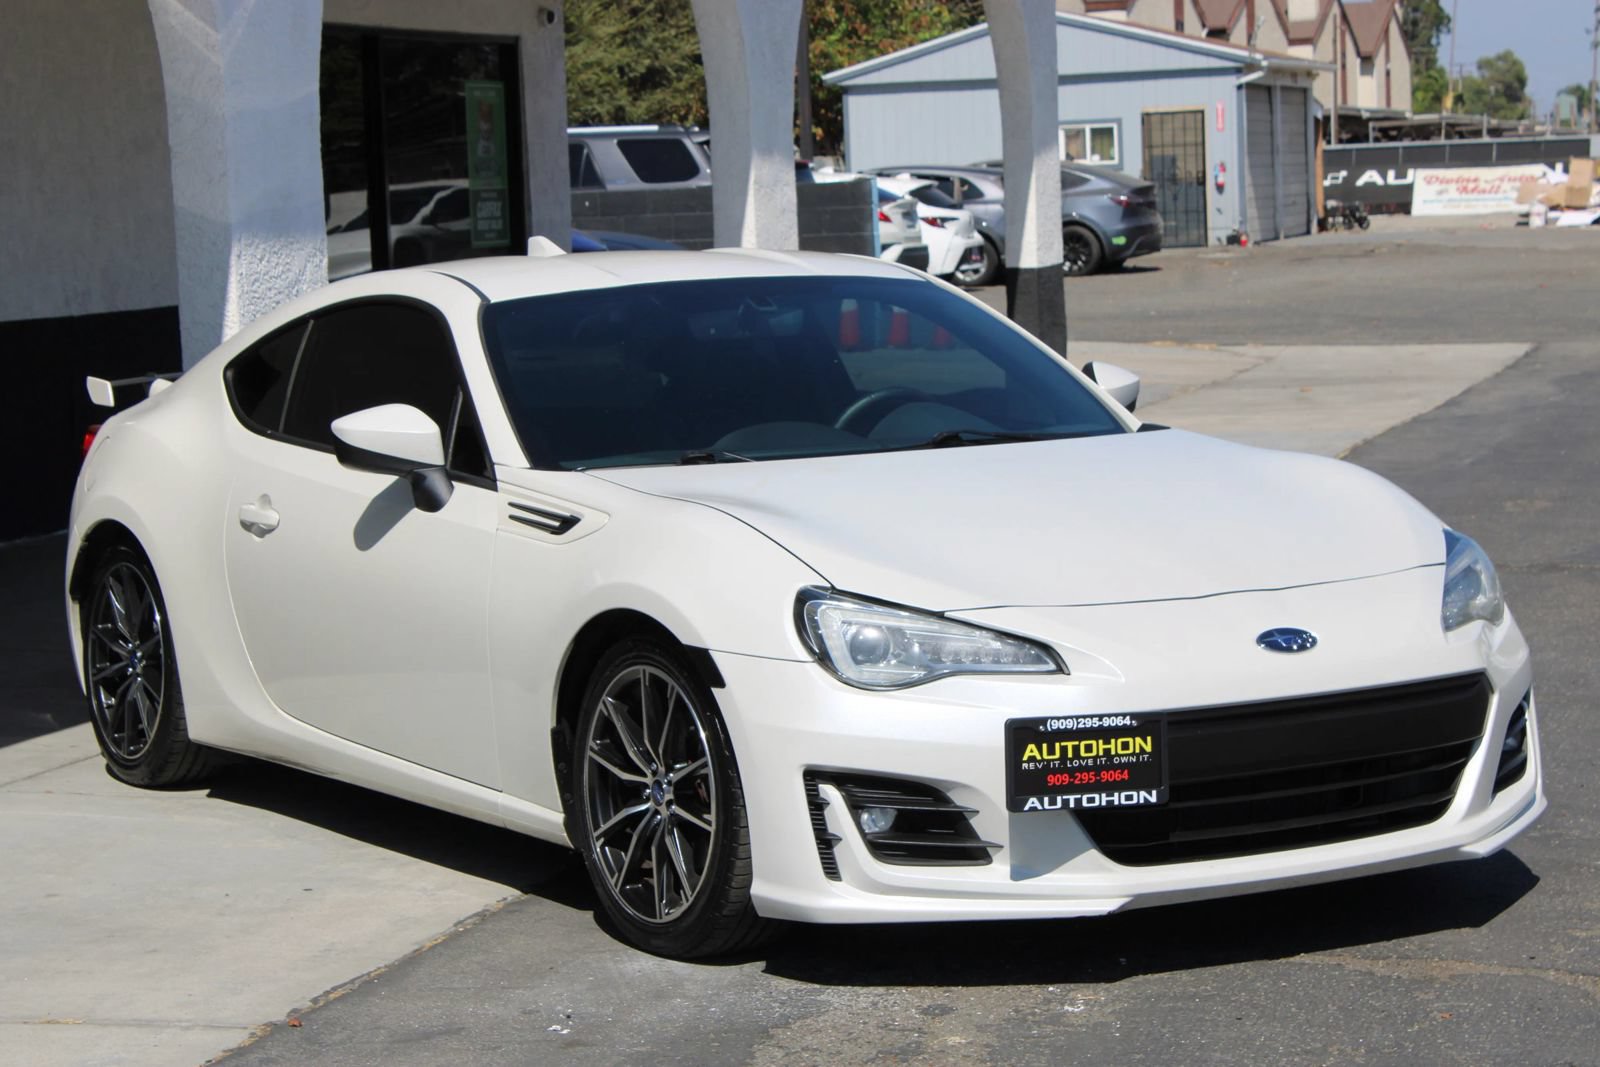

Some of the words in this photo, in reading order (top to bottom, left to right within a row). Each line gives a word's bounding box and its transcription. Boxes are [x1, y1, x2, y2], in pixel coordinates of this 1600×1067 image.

[1046, 715, 1131, 732] (909)295-9064
[1022, 736, 1152, 761] AUTOHON
[1050, 760, 1064, 768] IT.
[1067, 758, 1094, 767] LOVE
[1097, 757, 1110, 765] IT.
[1113, 755, 1137, 764] OWN
[1139, 754, 1152, 762] IT.
[1046, 769, 1130, 786] 909-295-9064
[1023, 790, 1158, 811] AUTOHON
